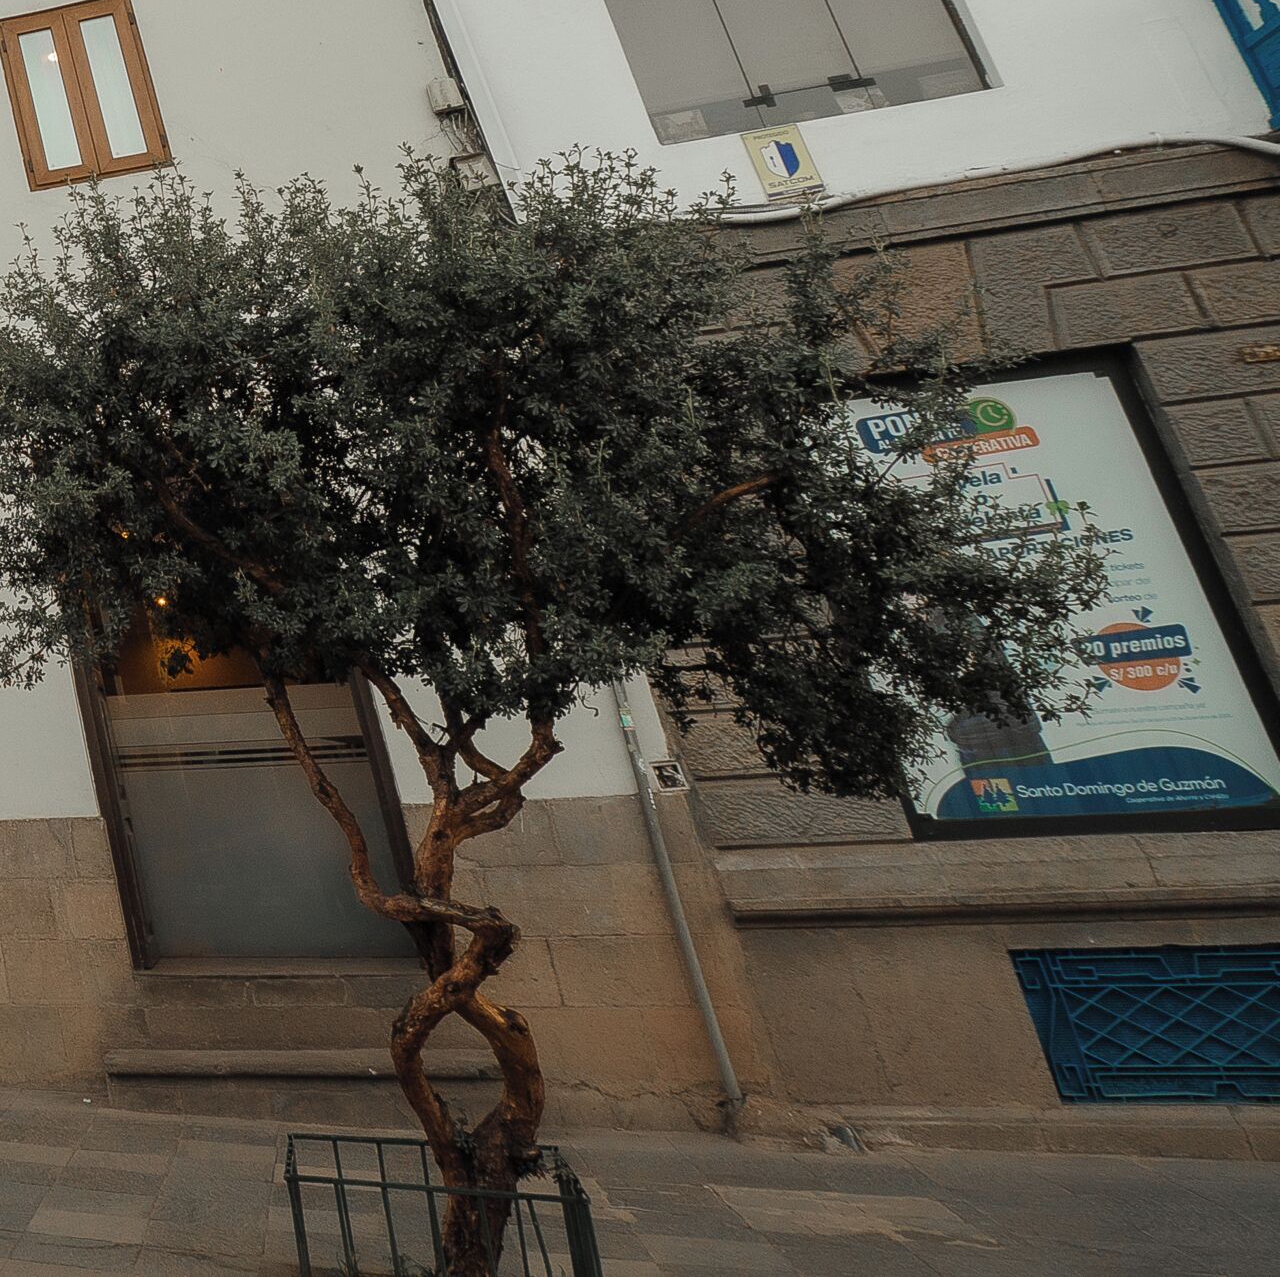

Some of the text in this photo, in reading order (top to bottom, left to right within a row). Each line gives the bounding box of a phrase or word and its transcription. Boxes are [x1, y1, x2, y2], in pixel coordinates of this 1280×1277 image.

[768, 176, 814, 188] SATCOM
[1109, 633, 1187, 659] premios
[1126, 664, 1154, 680] 300
[1155, 662, 1179, 677] c/u
[1016, 775, 1226, 799] Santo Domingo de Guzmán
